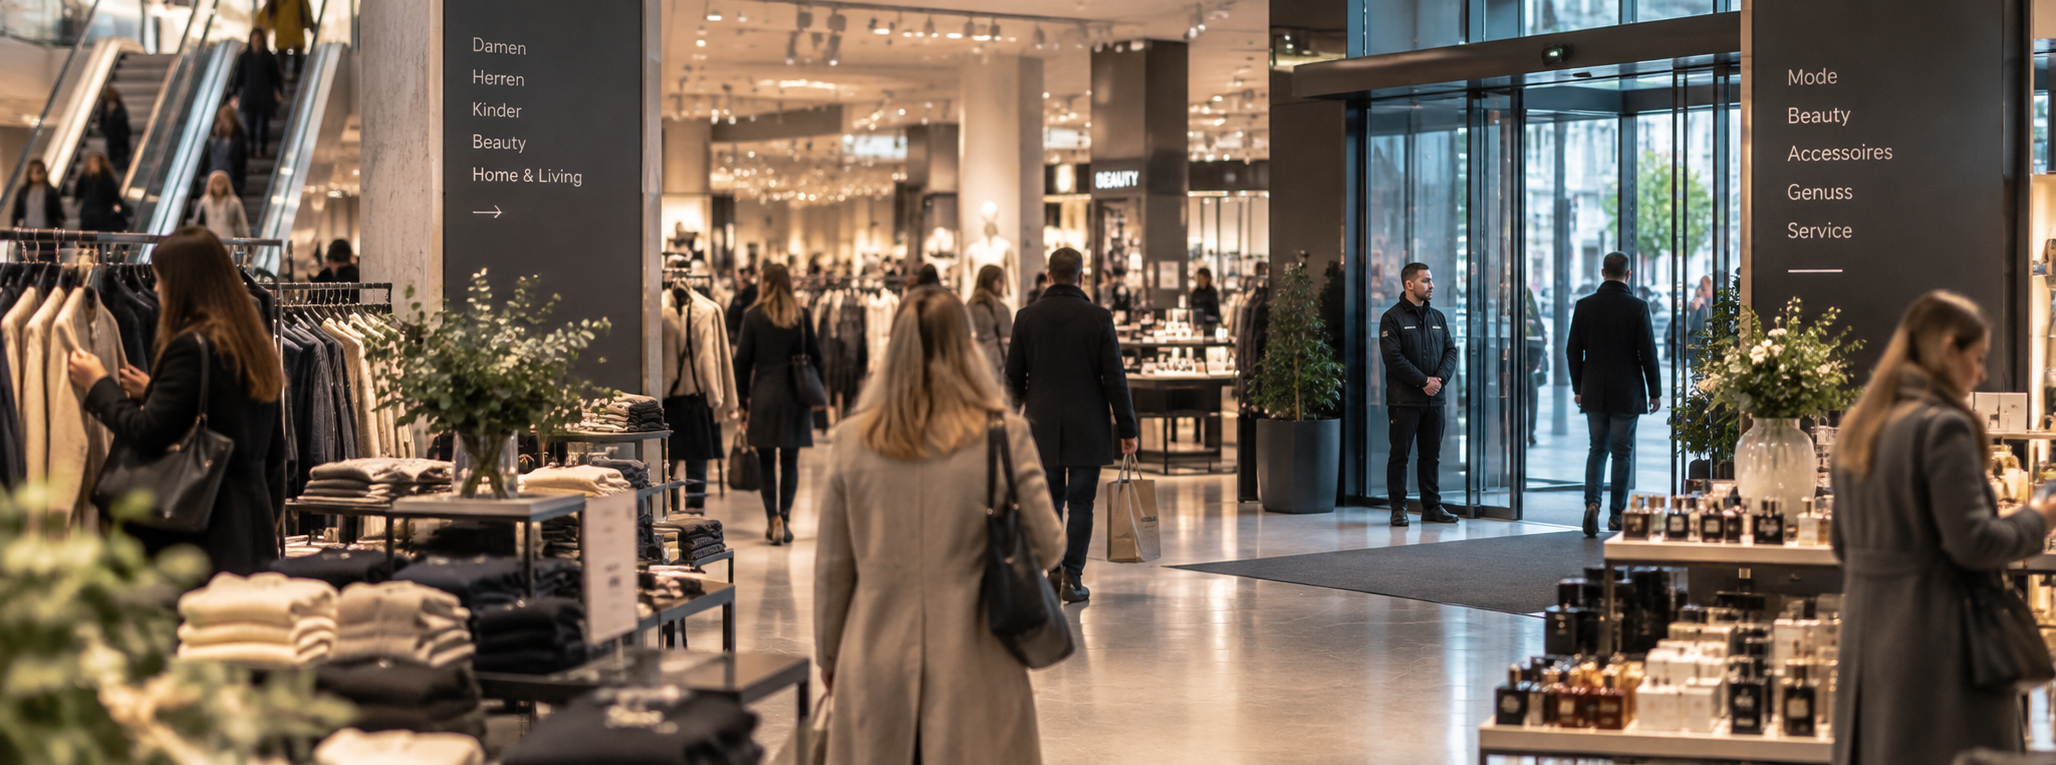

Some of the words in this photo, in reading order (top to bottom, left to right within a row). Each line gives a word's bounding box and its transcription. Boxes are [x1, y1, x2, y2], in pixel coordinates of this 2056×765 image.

[473, 36, 527, 55] Damen
[473, 69, 525, 87] Herren
[1788, 67, 1838, 86] Mode
[473, 101, 522, 119] Kinder
[1788, 106, 1851, 127] Beauty
[473, 134, 527, 154] Beauty
[1787, 143, 1893, 162] Accessoires
[473, 167, 519, 183] Home
[523, 168, 534, 183] &
[539, 168, 583, 187] Living
[1095, 170, 1139, 189] BEAUTY
[1787, 183, 1853, 201] Genuss
[1787, 221, 1853, 239] Service
